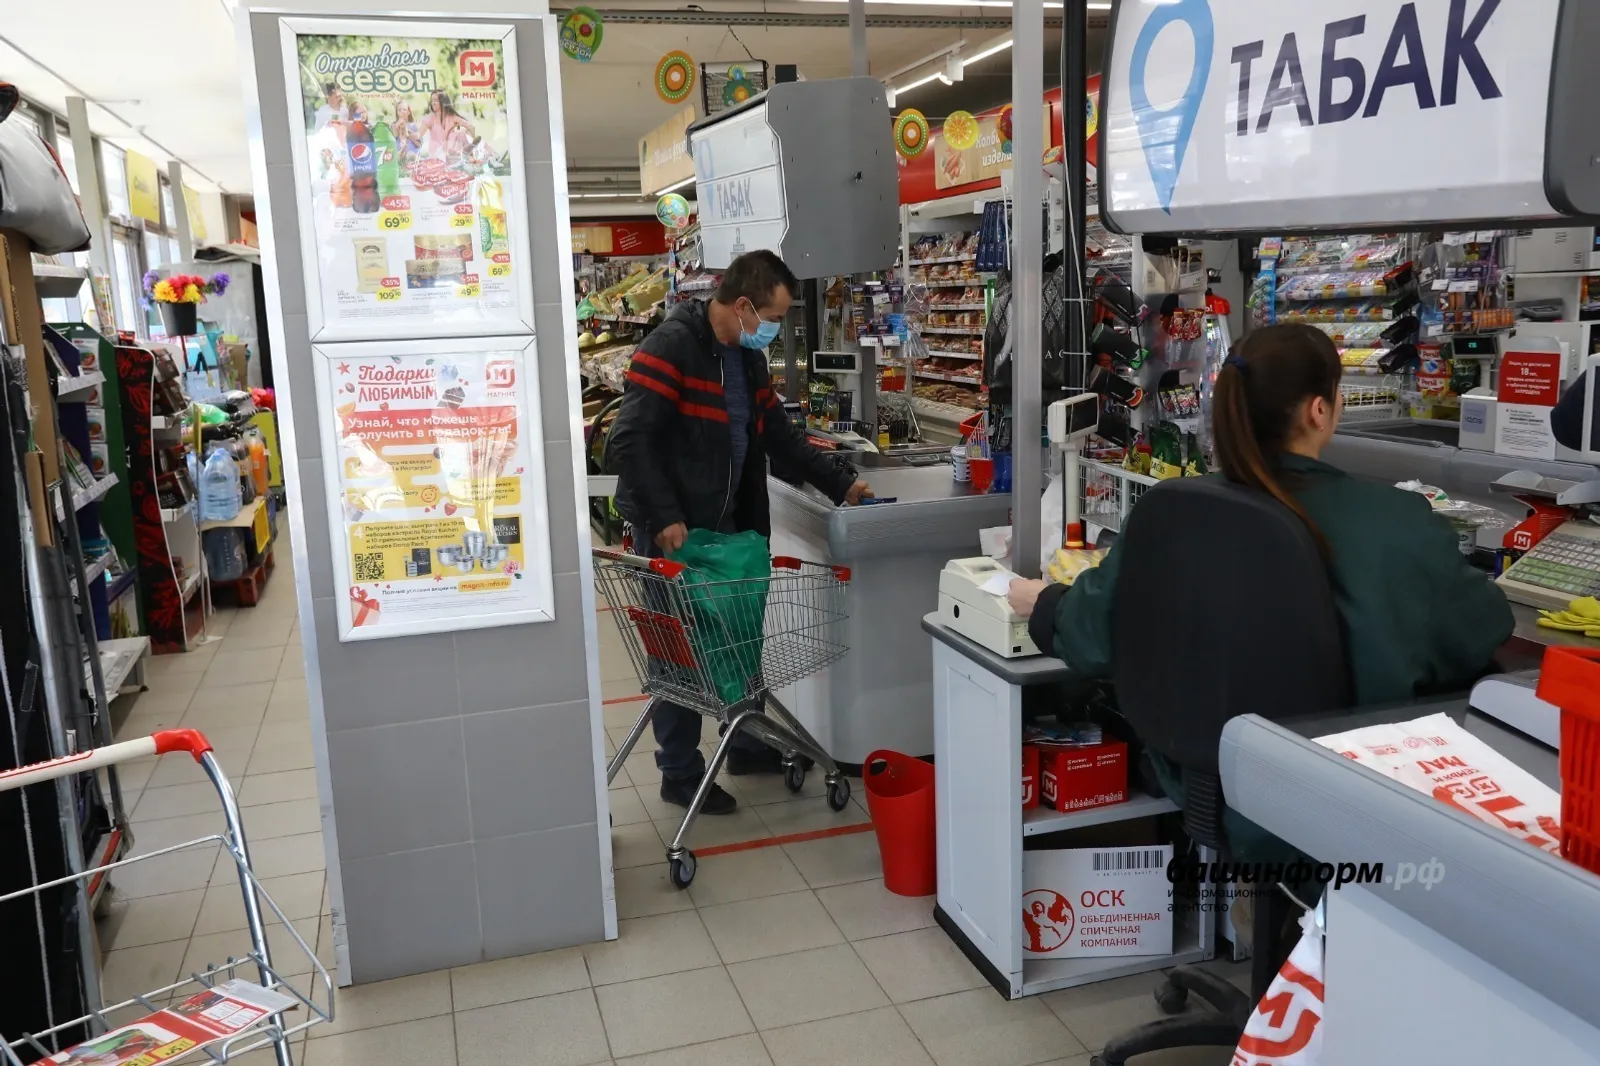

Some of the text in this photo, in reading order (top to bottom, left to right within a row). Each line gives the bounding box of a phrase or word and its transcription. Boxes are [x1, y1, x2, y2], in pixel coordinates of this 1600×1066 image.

[316, 43, 430, 74] Открываем
[1230, 0, 1503, 136] ТАБАК
[982, 150, 1012, 167] издели
[717, 177, 754, 220] ТАБАК
[1422, 350, 1440, 358] Persil
[358, 364, 436, 385] Подарки
[1521, 367, 1529, 375] 18
[358, 385, 438, 404] ЛЮБИМЫМ
[487, 390, 516, 398] МАГНИТ
[349, 415, 477, 429] Узнай, что можешь
[417, 430, 425, 438] в
[1080, 890, 1125, 908] ОСК
[1080, 925, 1141, 936] СПИЧЕЧНАЯ
[1080, 937, 1137, 948] КОМПАНИЯ
